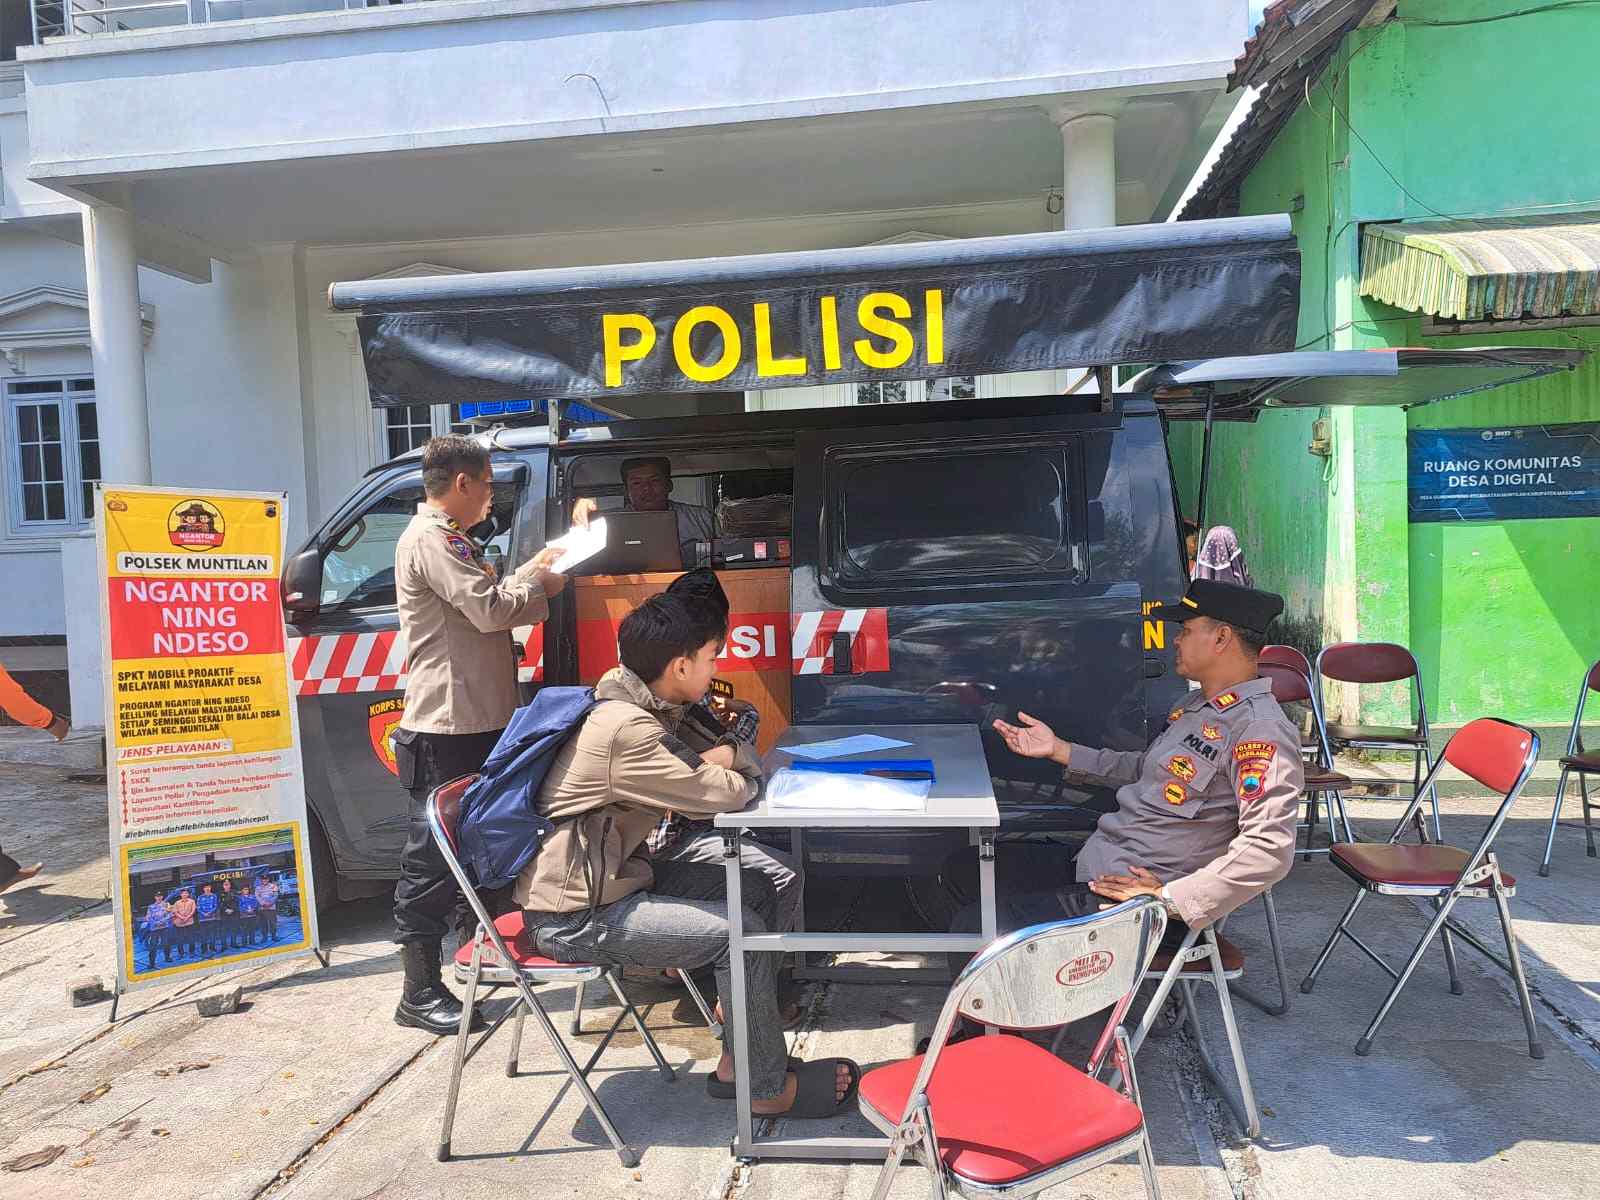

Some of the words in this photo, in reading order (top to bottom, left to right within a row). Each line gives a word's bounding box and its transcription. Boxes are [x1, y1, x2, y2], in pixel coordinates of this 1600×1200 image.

[602, 289, 944, 388] POLISI
[1423, 459, 1481, 473] RUANG
[1485, 455, 1582, 471] KOMUNITAS
[1448, 475, 1489, 487] DESA
[1494, 472, 1556, 486] DIGITAL
[124, 556, 182, 570] POLSEK
[186, 557, 268, 570] MUNTILAN
[124, 580, 269, 603] NGANTOR
[162, 606, 237, 628] NING
[153, 630, 249, 654] NDESO
[117, 671, 145, 681] SPKT
[148, 669, 185, 680] MOBILE
[188, 667, 235, 678] PROAKTIF
[117, 679, 170, 692] MELAYANI
[174, 678, 234, 689] MASYARAKAT
[238, 675, 262, 686] DESA
[119, 700, 163, 711] PROGRAM
[165, 698, 201, 709] NGANTOR
[203, 697, 222, 706] NING
[225, 695, 250, 705] NDESO
[369, 700, 396, 717] KORPS
[119, 709, 158, 721] KELILING
[161, 707, 199, 717] MELAYANI
[202, 704, 252, 713] MASYARAKAT
[120, 719, 150, 730] SETIAP
[152, 716, 196, 728] SEMINGGU
[197, 714, 223, 725] SEKALI
[226, 713, 234, 722] DI
[236, 711, 259, 721] BALAI
[260, 709, 281, 719] DESA
[120, 727, 159, 739] WILAYAH
[161, 723, 220, 736] KEC.MUNTILAN
[120, 746, 153, 759] JENIS
[156, 741, 221, 754] PELAYANAN
[1183, 734, 1218, 762] POLRI
